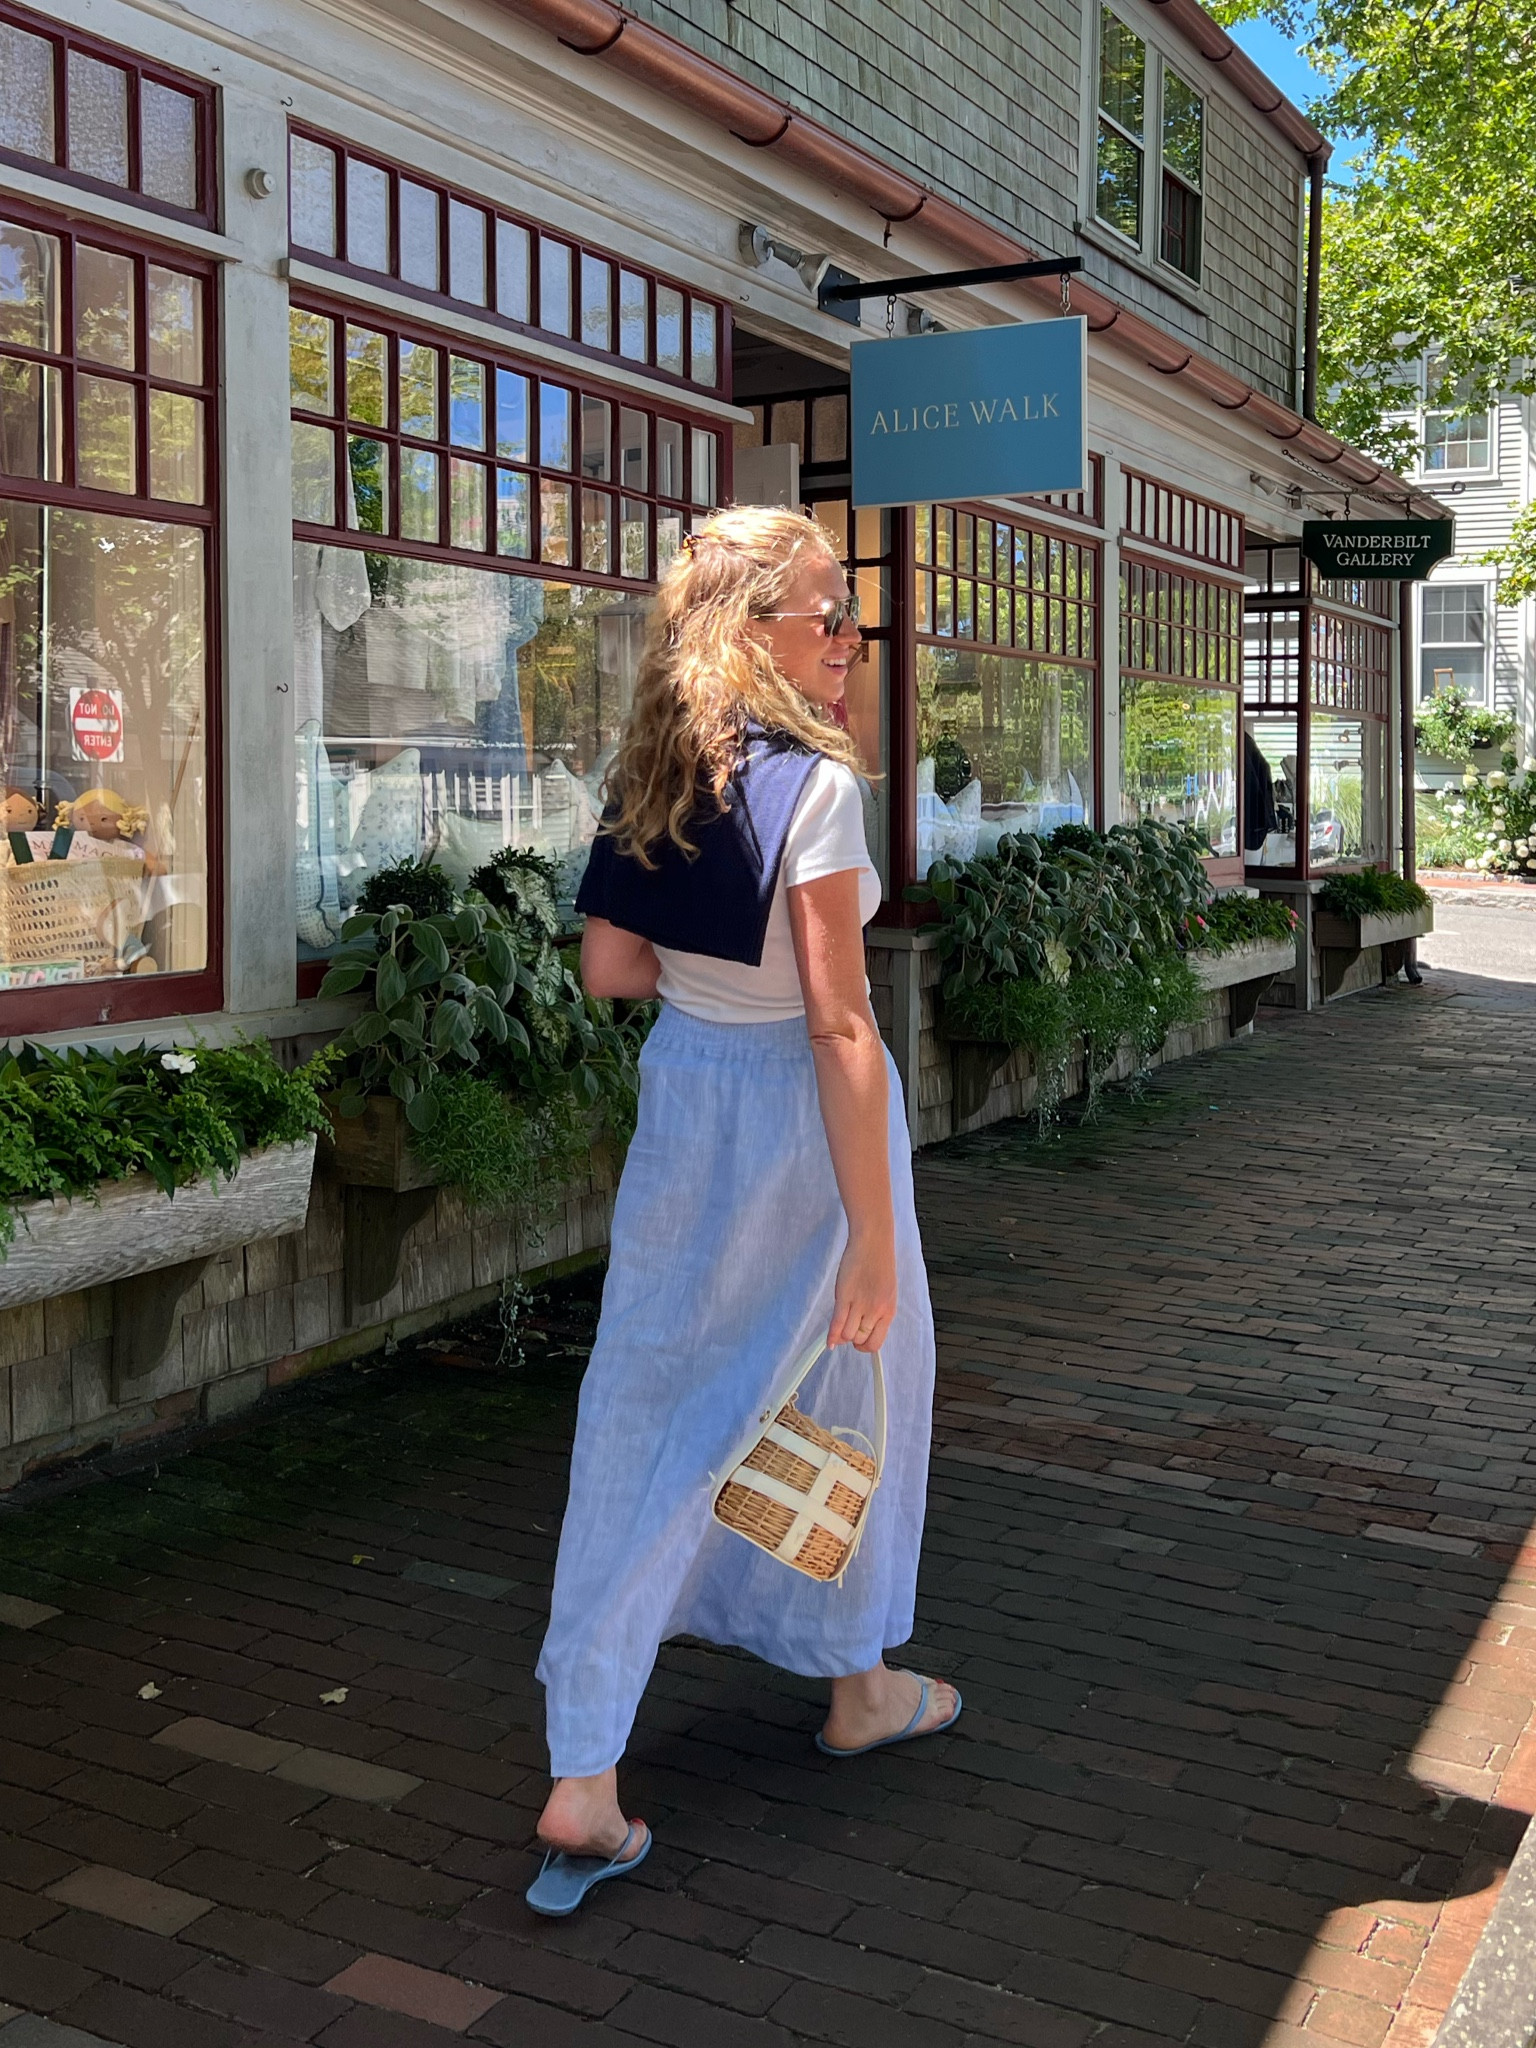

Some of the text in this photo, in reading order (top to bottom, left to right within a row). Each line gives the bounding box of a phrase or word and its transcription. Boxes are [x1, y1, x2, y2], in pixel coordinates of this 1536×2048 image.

[870, 393, 1060, 435] ALICE WALK
[1323, 534, 1431, 549] VANDERBILT
[1336, 552, 1415, 566] GALLERY
